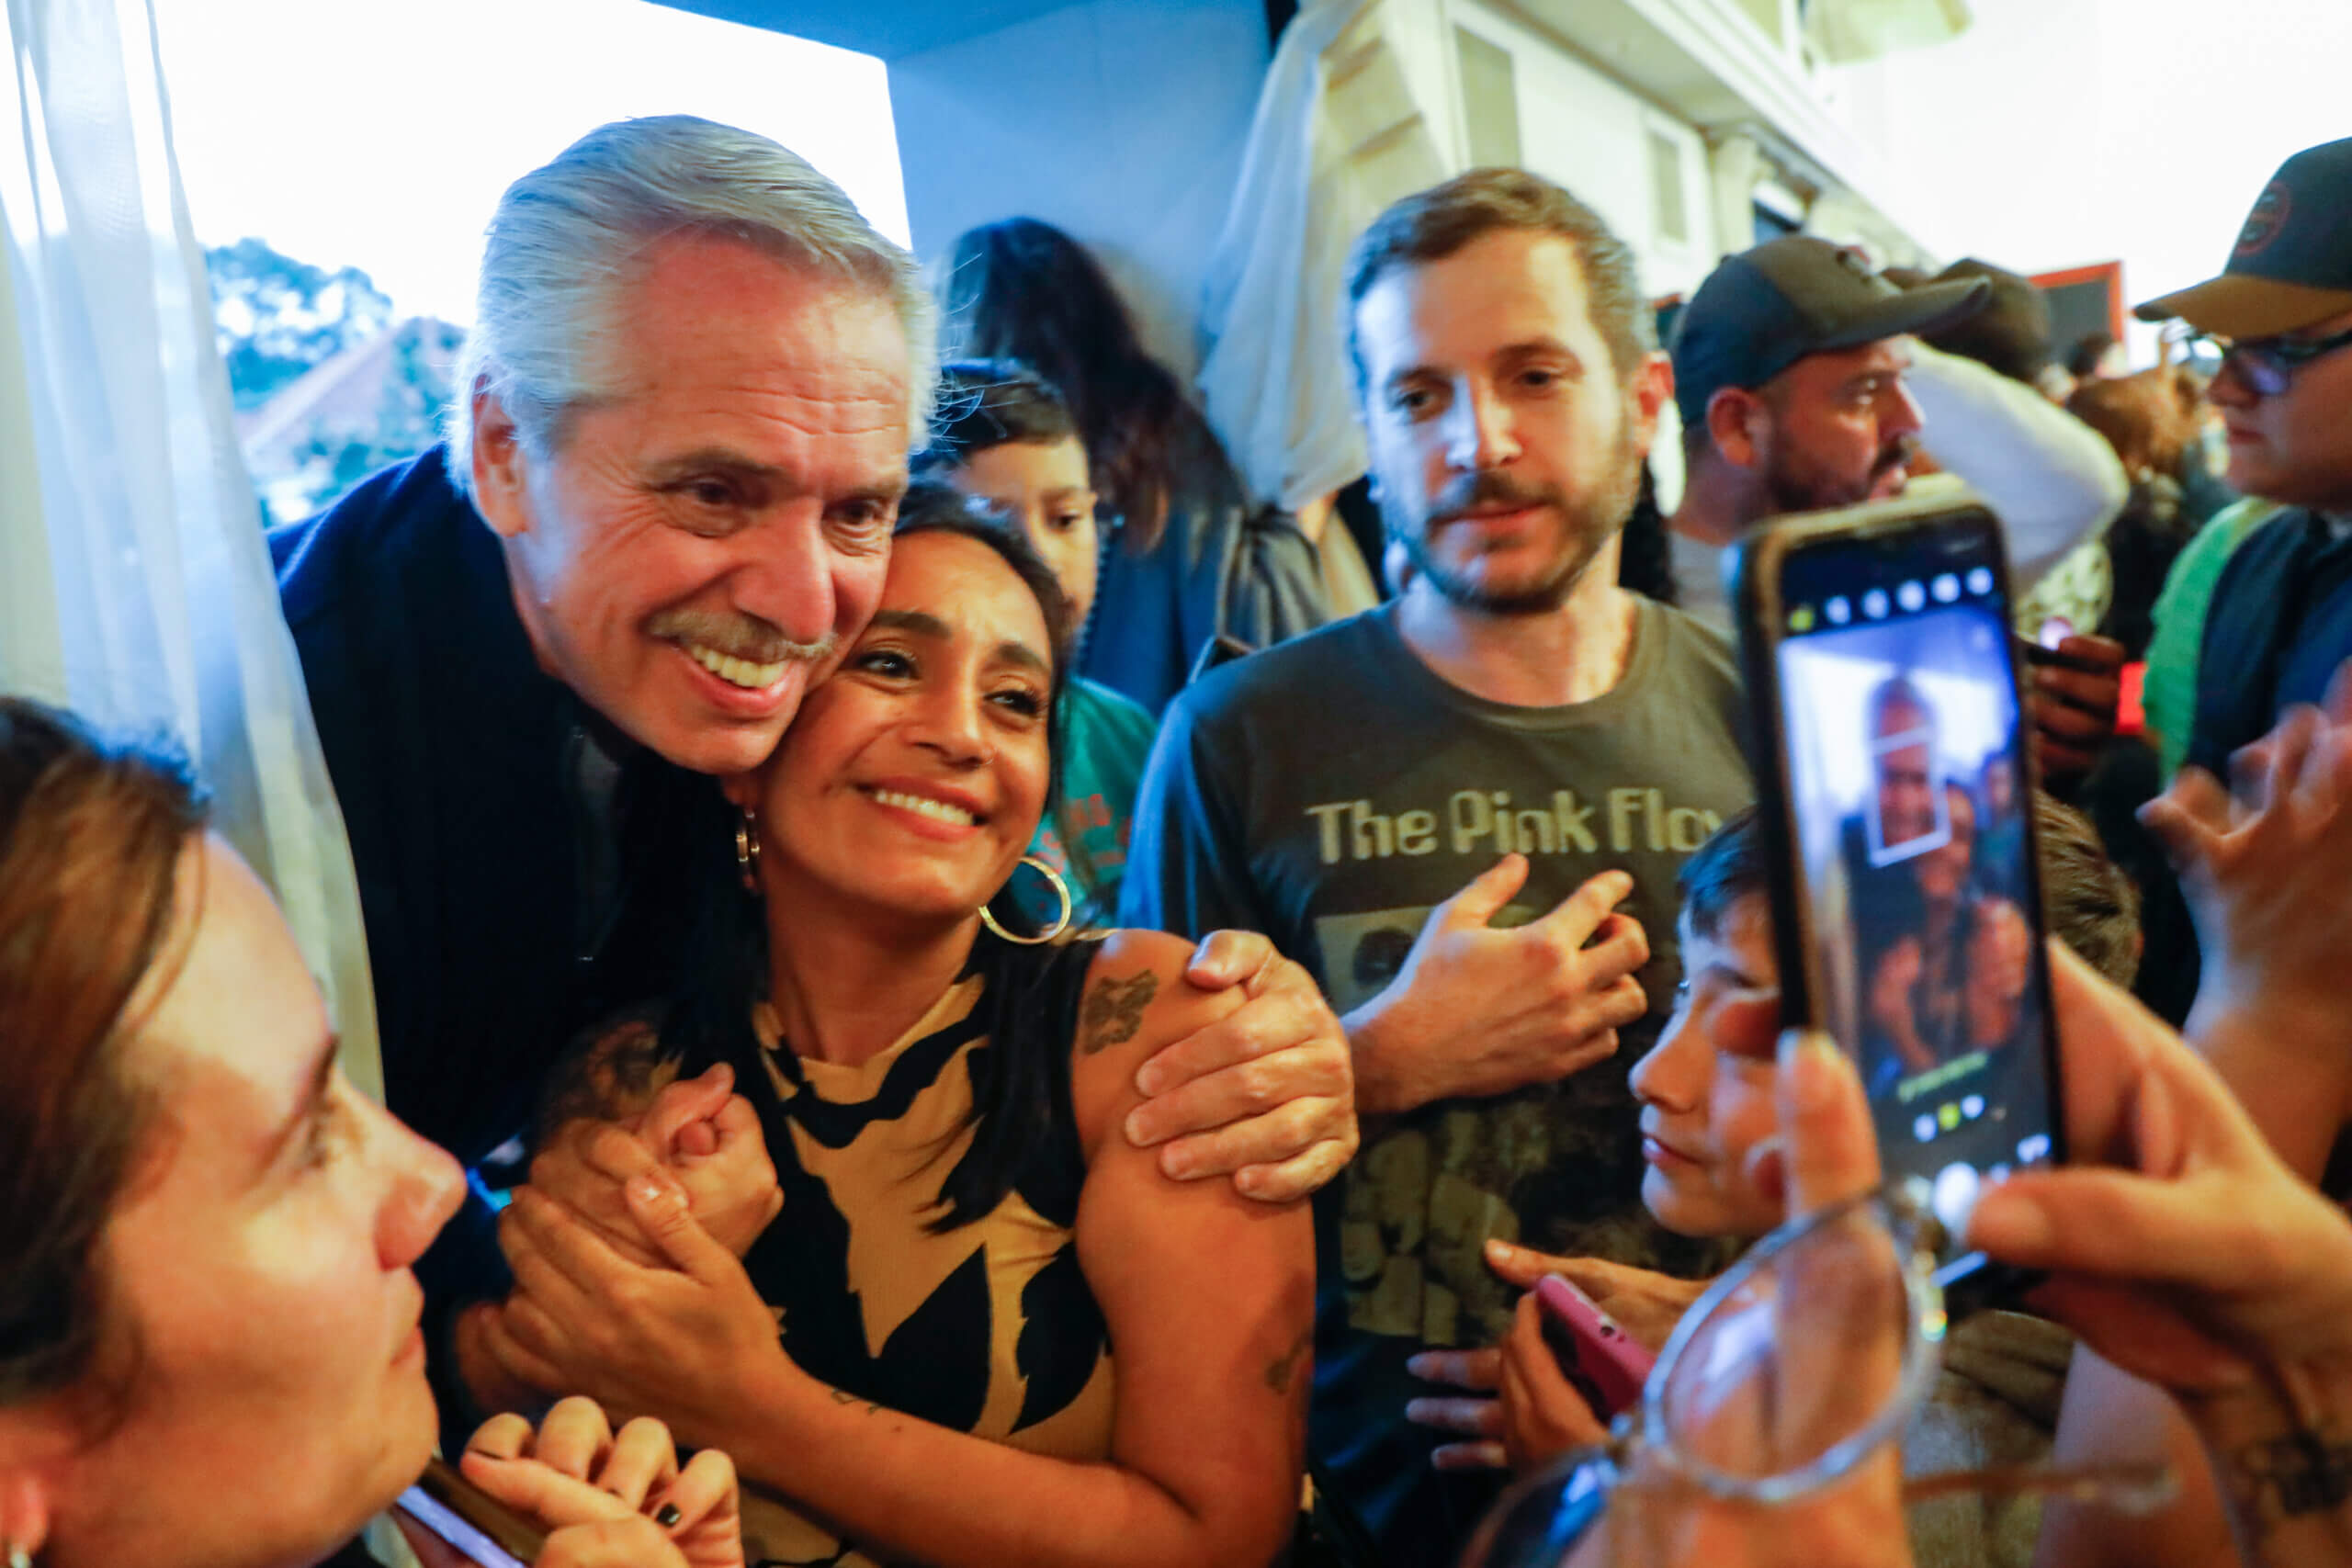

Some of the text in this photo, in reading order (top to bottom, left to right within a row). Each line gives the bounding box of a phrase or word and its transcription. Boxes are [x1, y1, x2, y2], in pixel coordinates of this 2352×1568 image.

[1305, 787, 1723, 864] The Pink Flo
